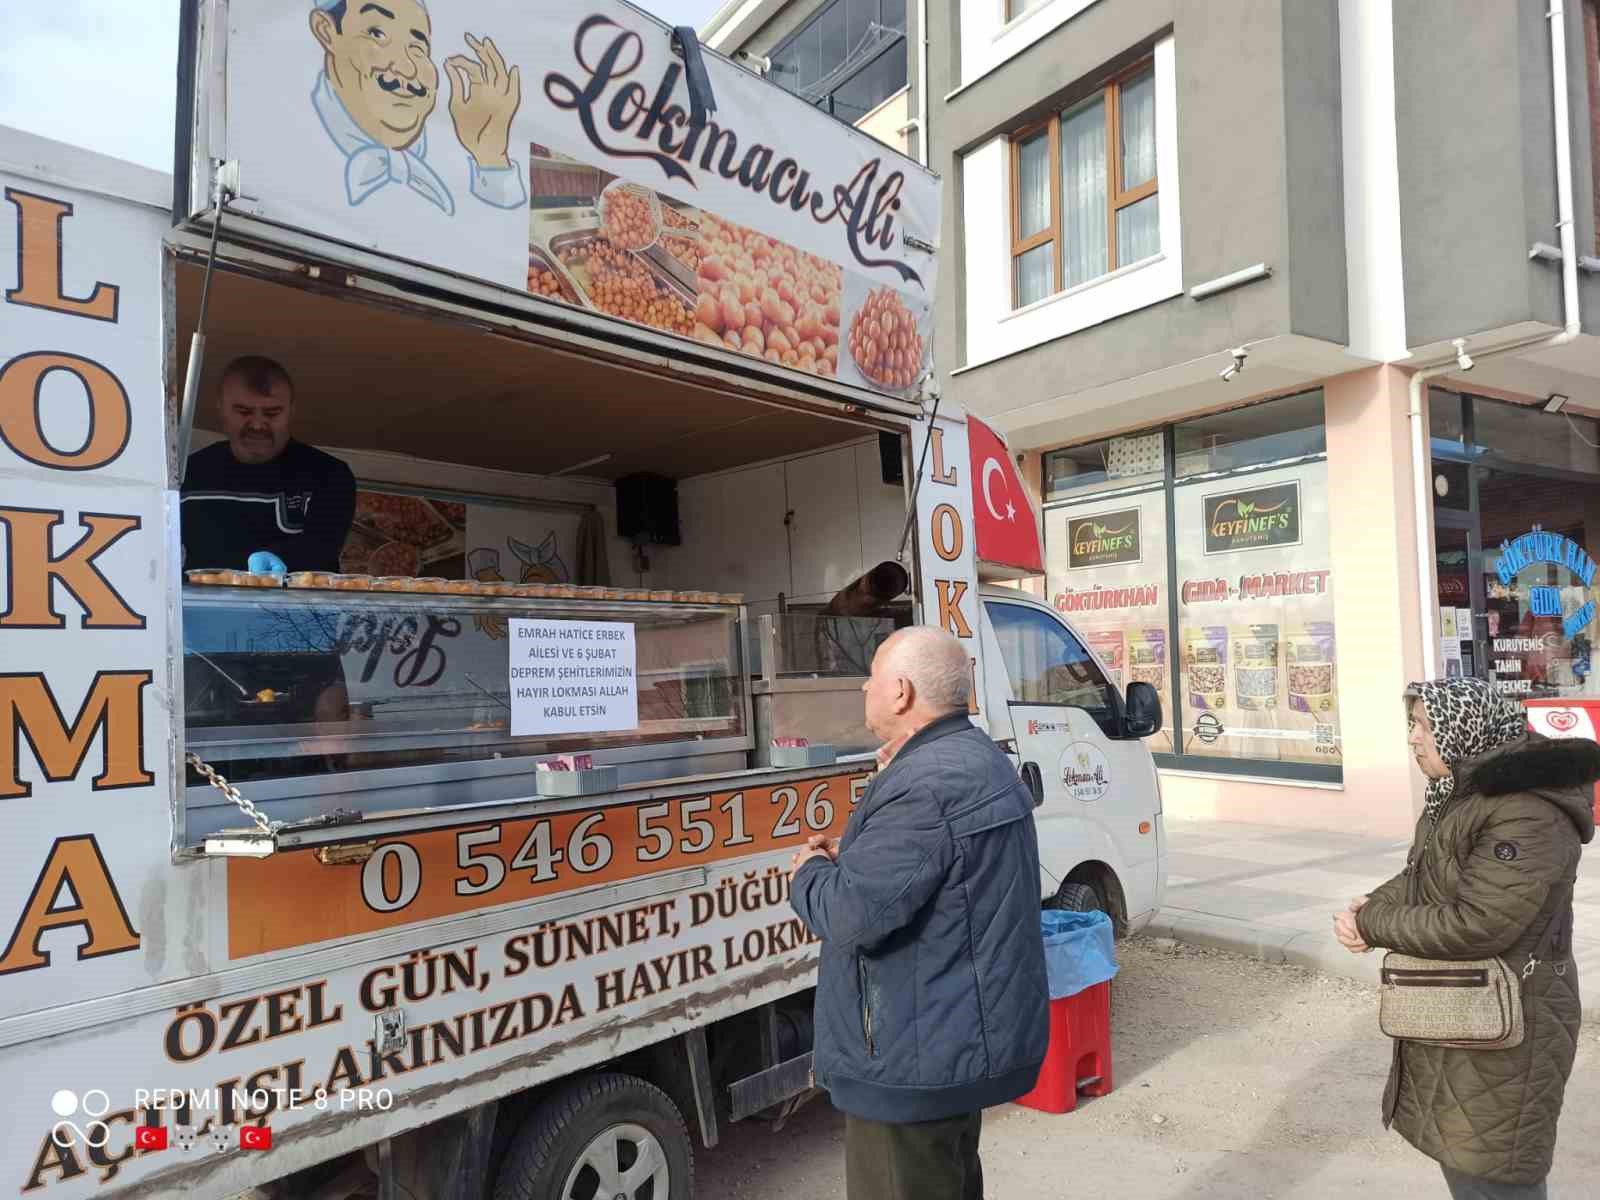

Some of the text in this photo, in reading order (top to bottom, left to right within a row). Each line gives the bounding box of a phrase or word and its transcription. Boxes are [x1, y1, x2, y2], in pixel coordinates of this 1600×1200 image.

[811, 156, 925, 291] Ali
[0, 186, 155, 976] LOKMA
[518, 627, 626, 641] EMRAH HATİCE ERBEK
[1492, 635, 1544, 653] KURUYEMİŞ
[528, 645, 616, 662] AİLESİ VE 6 ŞUBAT
[511, 664, 633, 680] DEPREM ŞEHİTLERİMİZİN
[1494, 656, 1522, 672] TAHİN
[516, 685, 629, 699] HAYIR LOKMASI ALLAH
[543, 703, 607, 718] KABUL ETSİN
[361, 842, 422, 914] 0
[455, 811, 614, 897] 546
[635, 792, 753, 863] 551
[771, 781, 835, 841] 26
[163, 864, 793, 1064] ÖZEL GÜN, SÜNNET, DÜĞÜ
[595, 944, 717, 1013] HAYIR
[724, 917, 822, 970] LOKM
